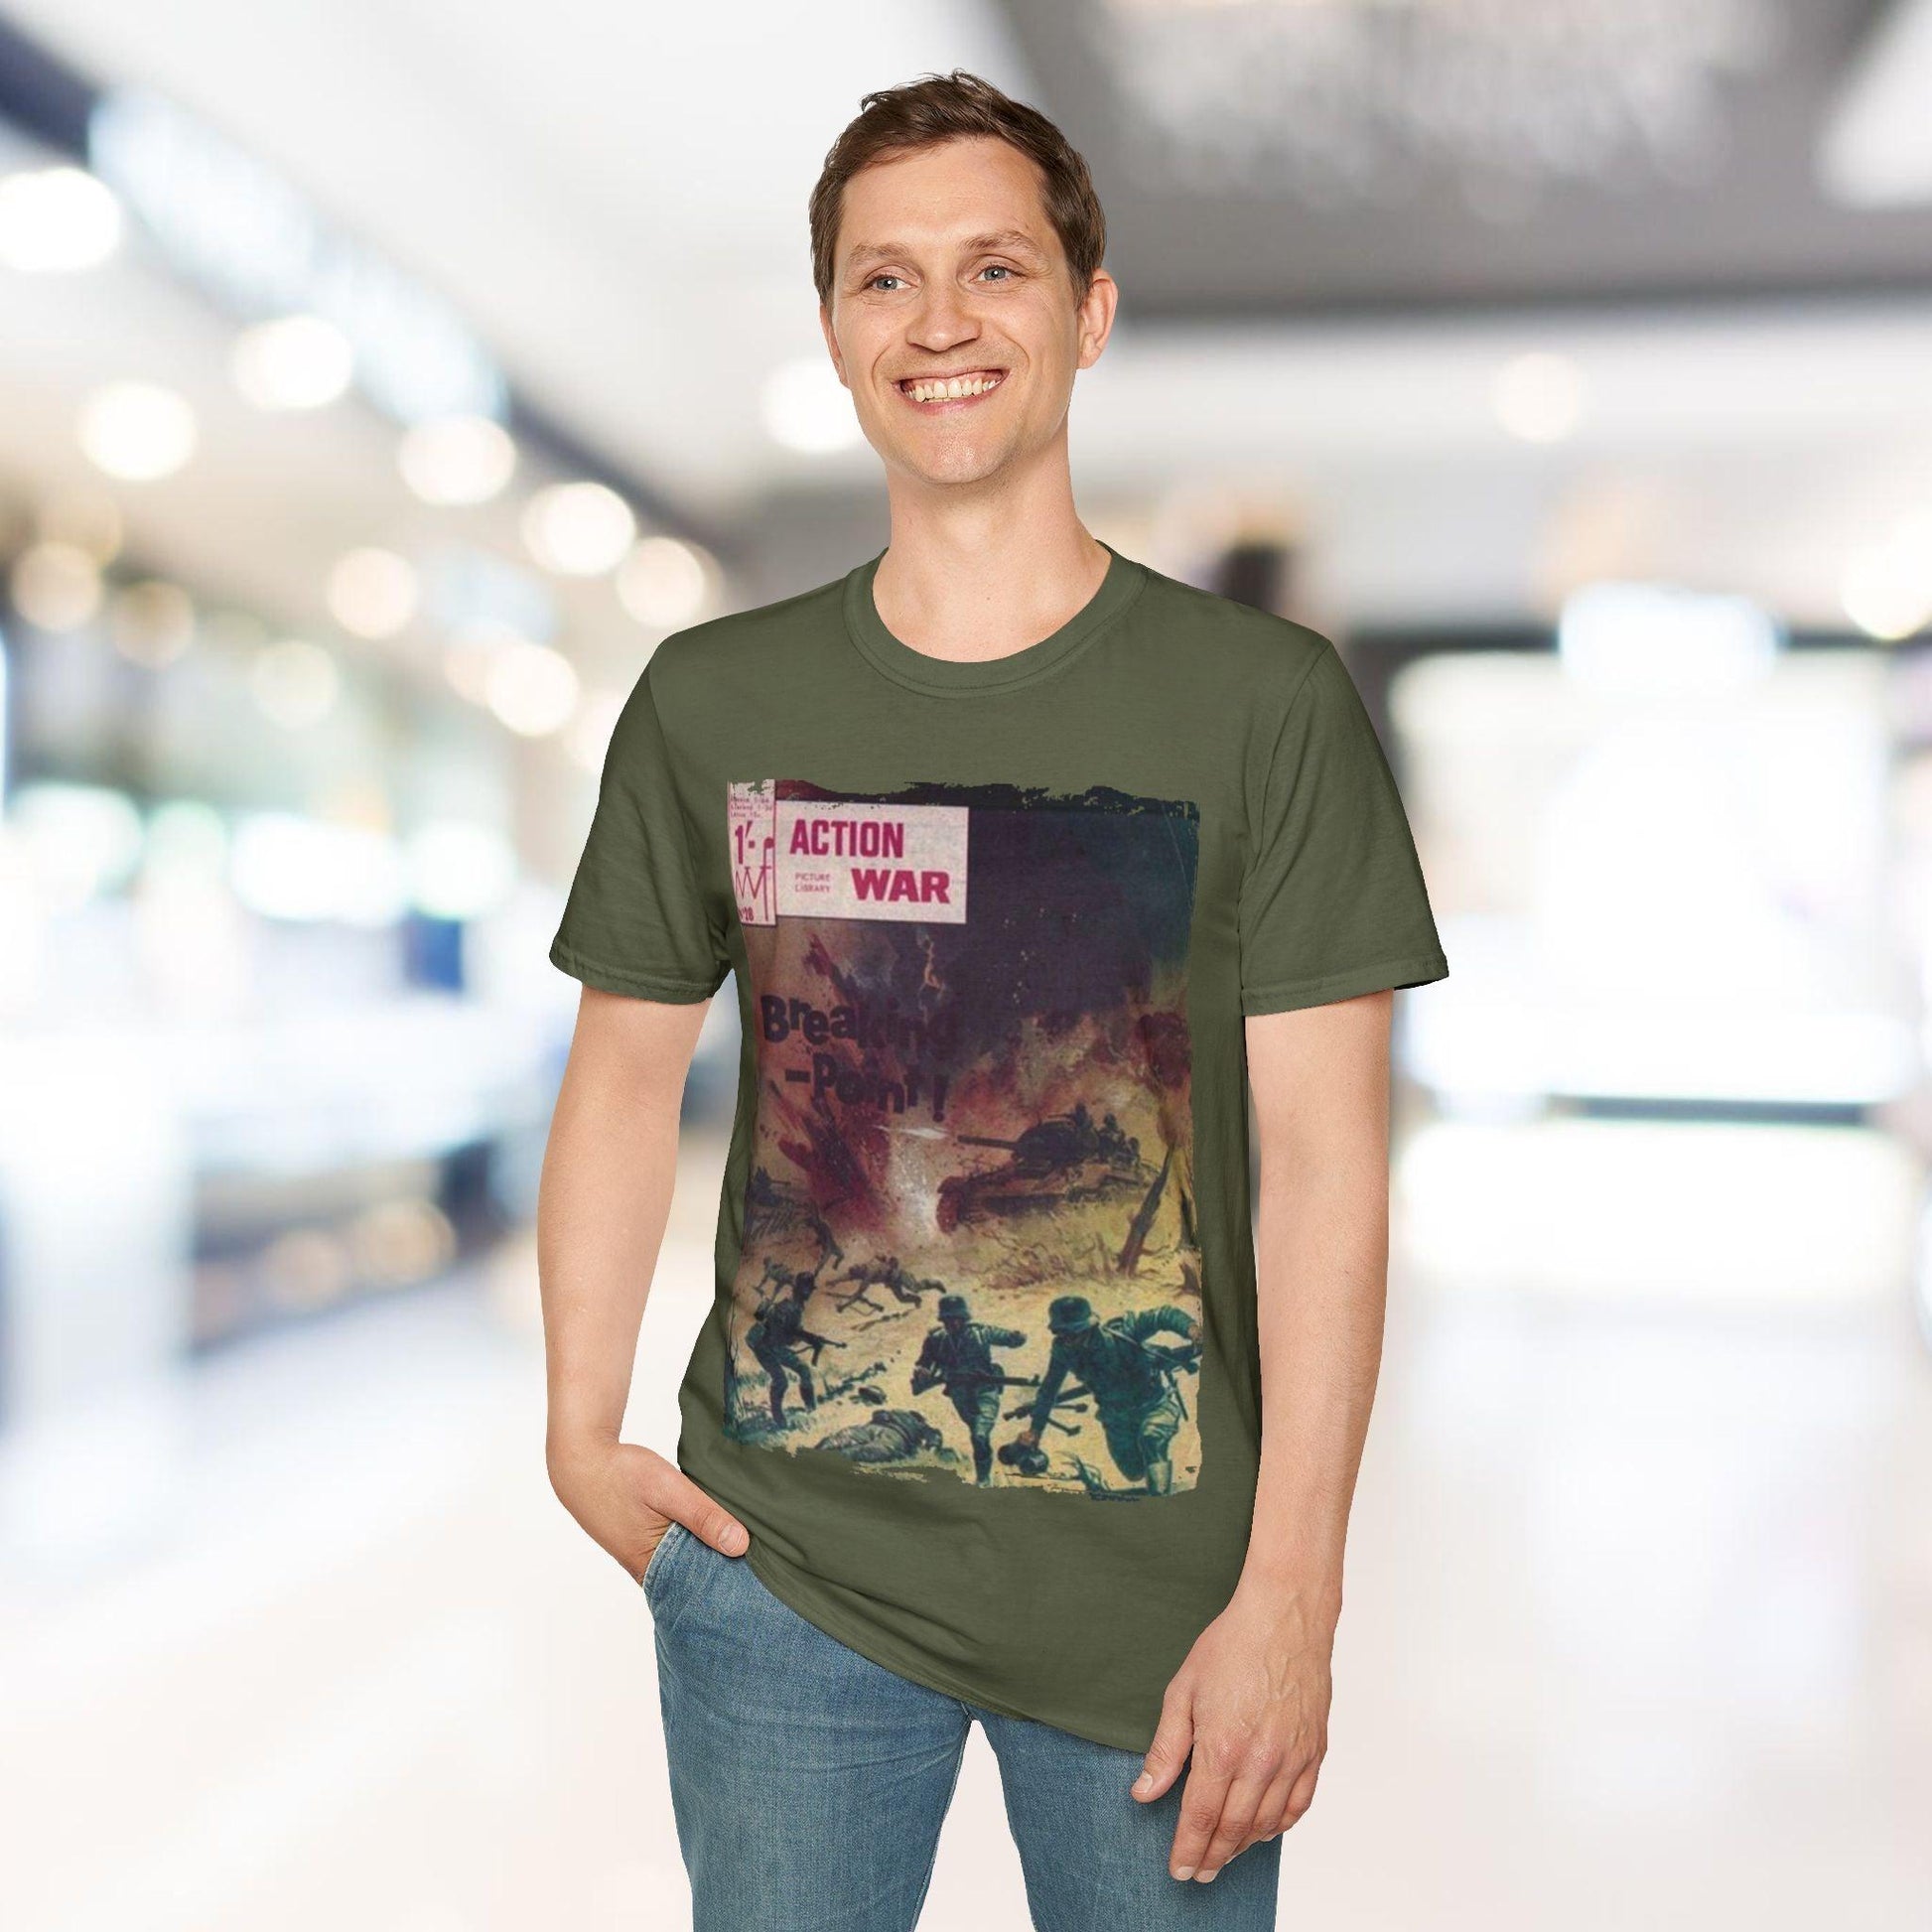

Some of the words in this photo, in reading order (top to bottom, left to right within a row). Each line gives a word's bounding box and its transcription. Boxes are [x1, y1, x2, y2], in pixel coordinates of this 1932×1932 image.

[789, 818, 904, 859] ACTION
[794, 872, 831, 883] PICTURE
[794, 883, 830, 894] LIBRARY
[851, 868, 950, 904] WAR
